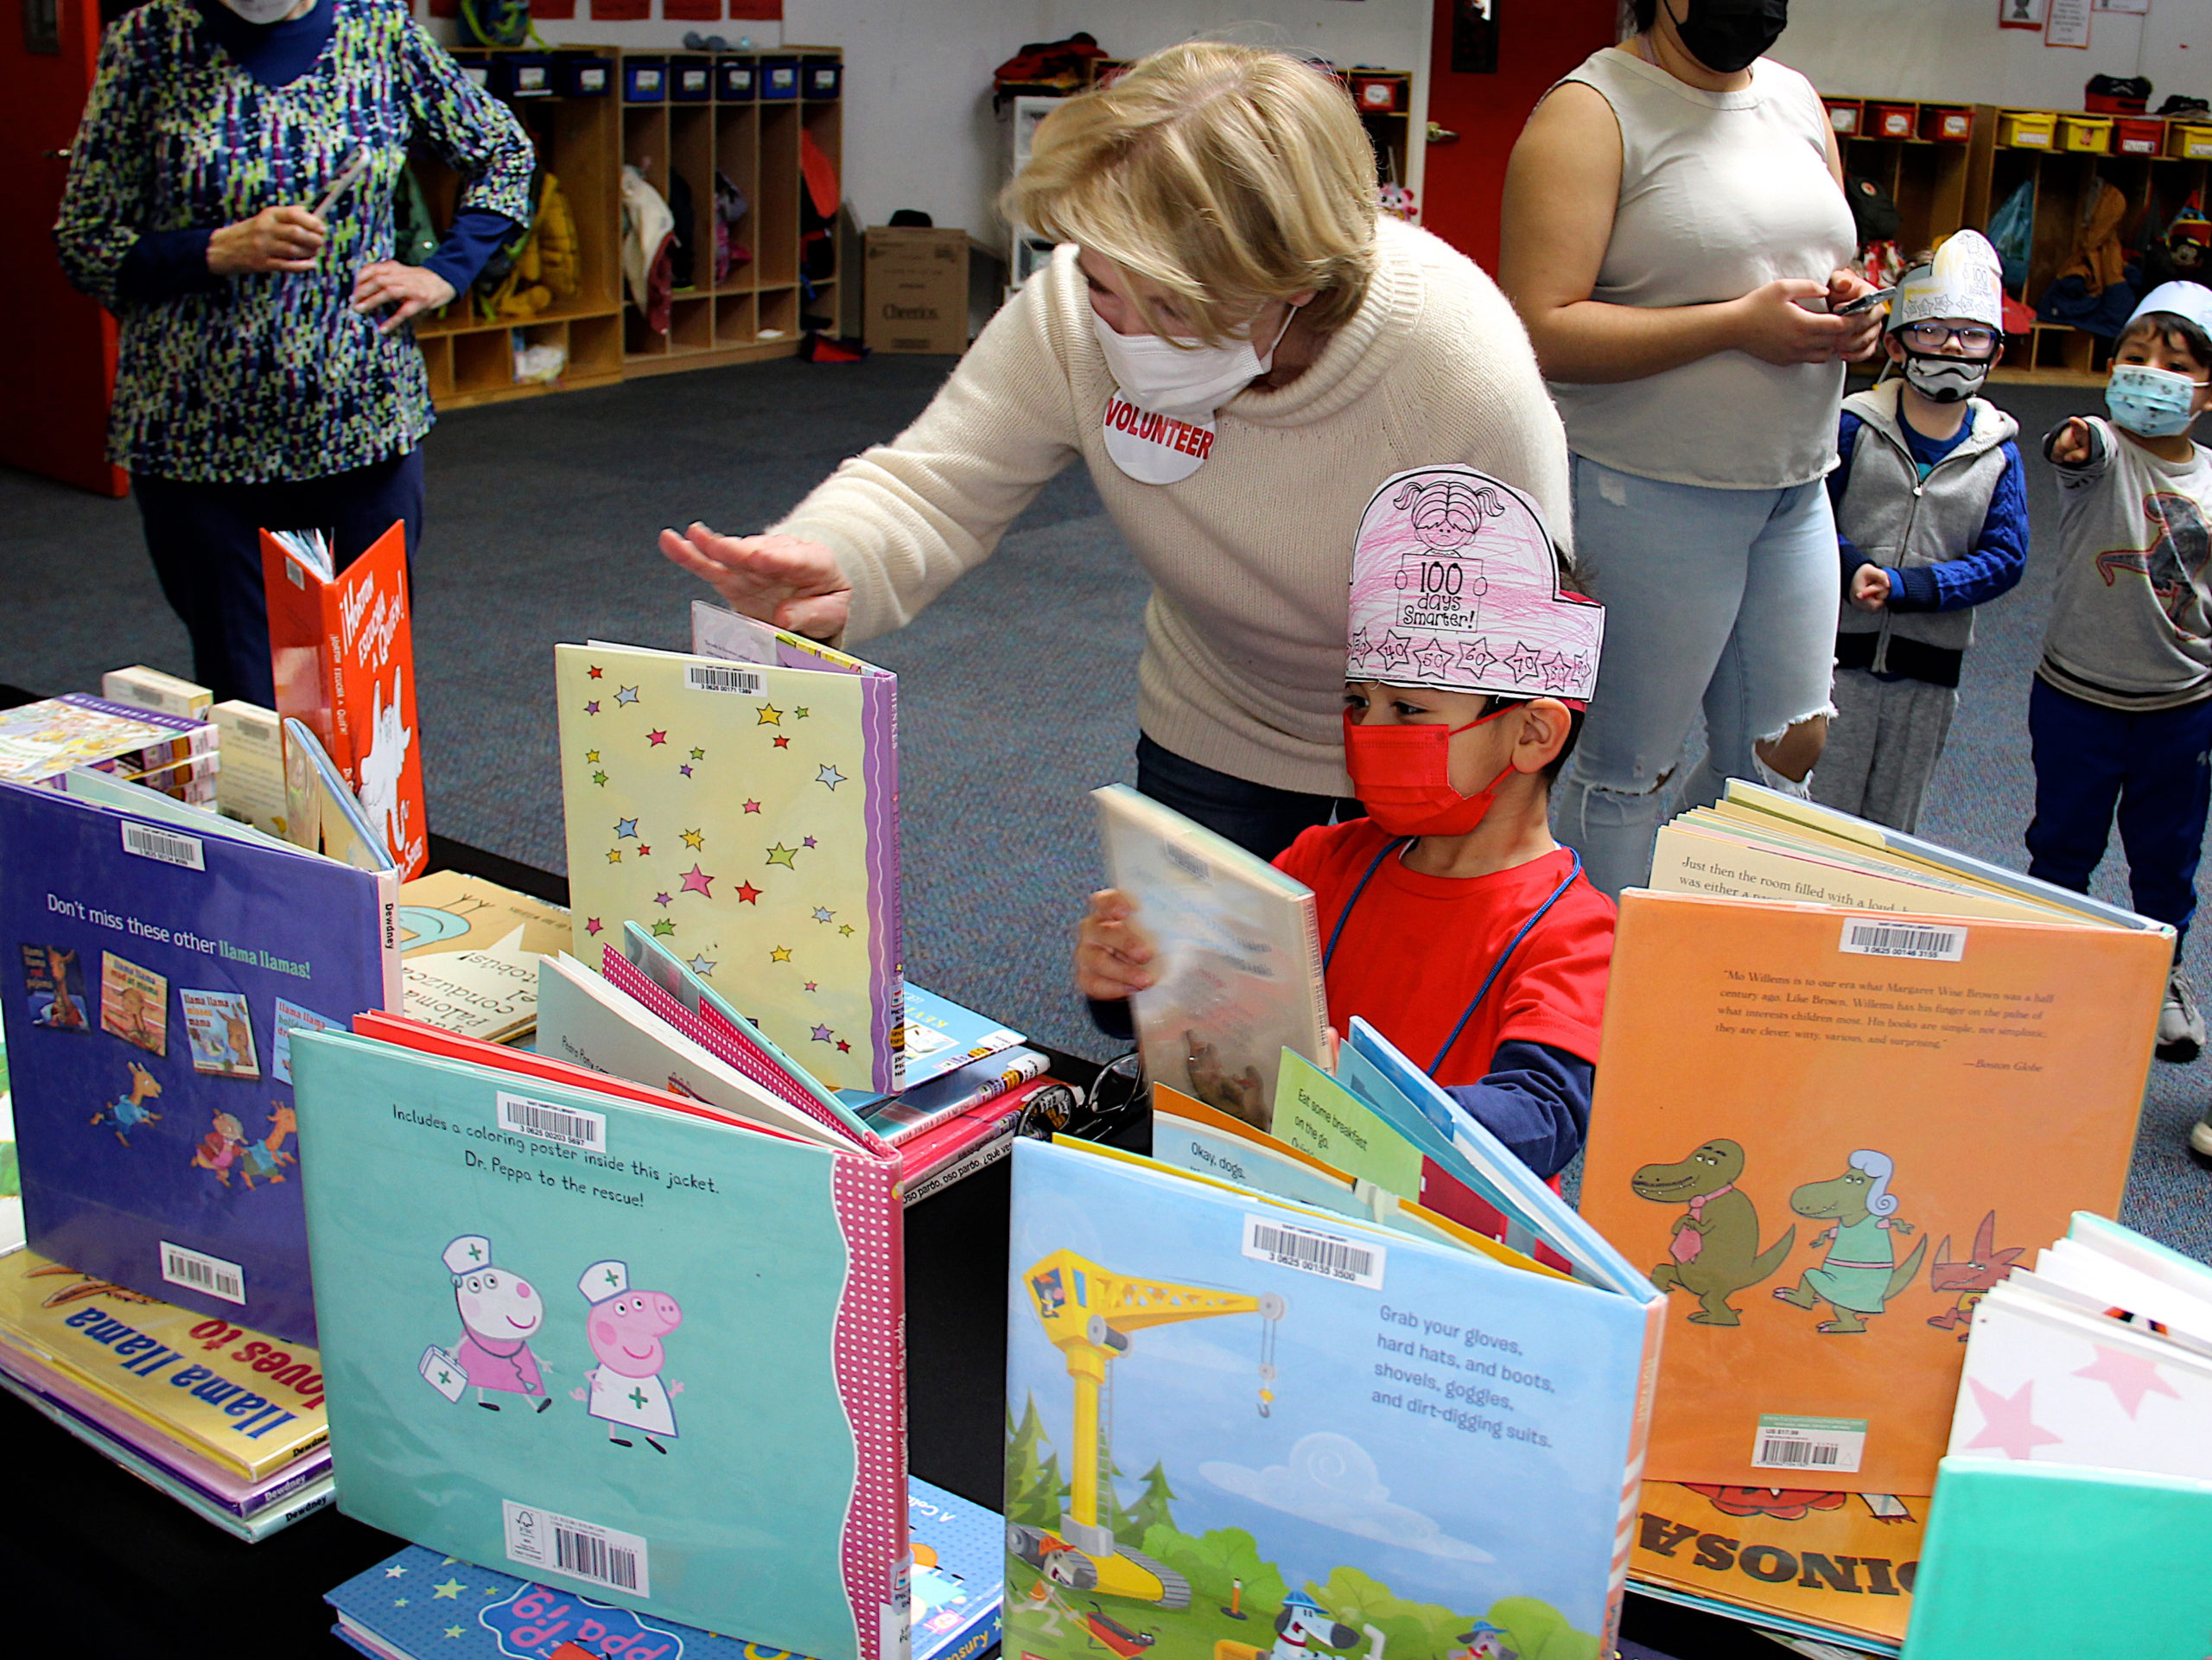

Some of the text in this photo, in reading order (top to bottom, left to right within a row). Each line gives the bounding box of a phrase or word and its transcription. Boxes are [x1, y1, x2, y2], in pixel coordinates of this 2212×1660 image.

[1105, 398, 1214, 460] VOLUNTEER
[1421, 562, 1463, 595] 100
[1403, 605, 1474, 629] Smarter!
[1417, 593, 1461, 611] days
[1422, 652, 1444, 667] 50
[1465, 647, 1485, 665] 60
[1679, 876, 1701, 888] was
[1704, 879, 1738, 897] either
[1681, 856, 1706, 873] Just
[1710, 863, 1735, 879] then
[1738, 869, 1757, 883] the
[1760, 877, 1790, 892] room
[1794, 881, 1824, 899] filled
[1827, 890, 1853, 906] with
[1857, 899, 1865, 908] a
[48, 894, 311, 979] Don't miss these other llama llamas!
[385, 903, 395, 950] Dewdney
[393, 1104, 720, 1194] Includes a coloring poster inside this jacket.
[465, 1150, 644, 1207] Dr. Peppa to the rescue!
[944, 1172, 957, 1183] oso
[189, 1320, 244, 1352] to
[1380, 1305, 1418, 1327] Grab
[1423, 1319, 1460, 1338] your
[1377, 1333, 1414, 1356] hard
[1465, 1358, 1497, 1377] and
[65, 1307, 299, 1440] llama llama
[1371, 1390, 1402, 1409] and
[1407, 1398, 1503, 1439] dirt-digging
[293, 1434, 328, 1457] Dewdne
[264, 1474, 306, 1502] Dewdney
[285, 1494, 327, 1523] Dewdney
